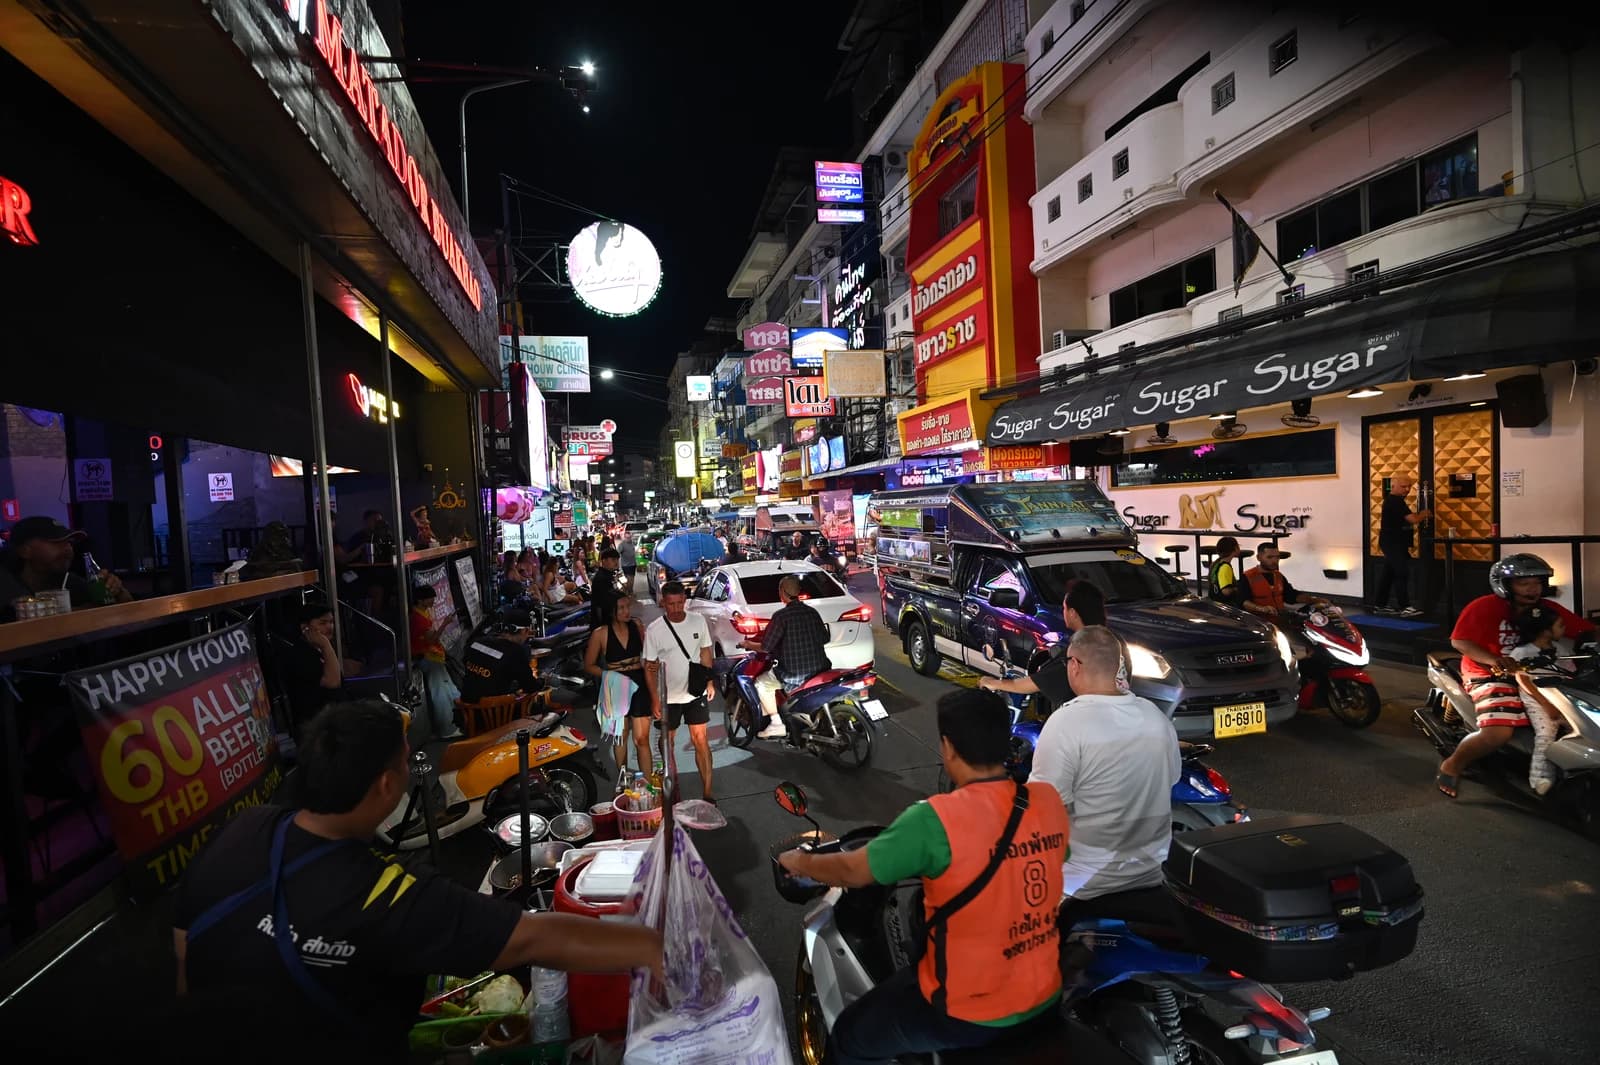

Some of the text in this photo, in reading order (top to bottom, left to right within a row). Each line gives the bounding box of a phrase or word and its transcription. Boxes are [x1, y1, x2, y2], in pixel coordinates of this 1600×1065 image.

[314, 0, 431, 231] MATADOR
[914, 255, 976, 315] มังกรทอง
[917, 315, 976, 364] เยาวราช
[1247, 345, 1387, 395] Sugar
[749, 387, 784, 400] พลอ
[1133, 380, 1227, 415] Sugar
[990, 415, 1042, 440] Sugar
[1048, 402, 1116, 431] Sugar
[562, 432, 606, 441] DRUGS
[993, 447, 1042, 460] มงกรทอง
[1123, 506, 1169, 531] Sugar
[1234, 503, 1312, 534] Sugar
[80, 629, 252, 710] HAPPY HOUR
[1216, 654, 1254, 665] ISUZU
[1220, 710, 1263, 728] 10-6910
[101, 704, 204, 804] 60
[140, 779, 208, 836] THB
[1023, 859, 1048, 908] 8
